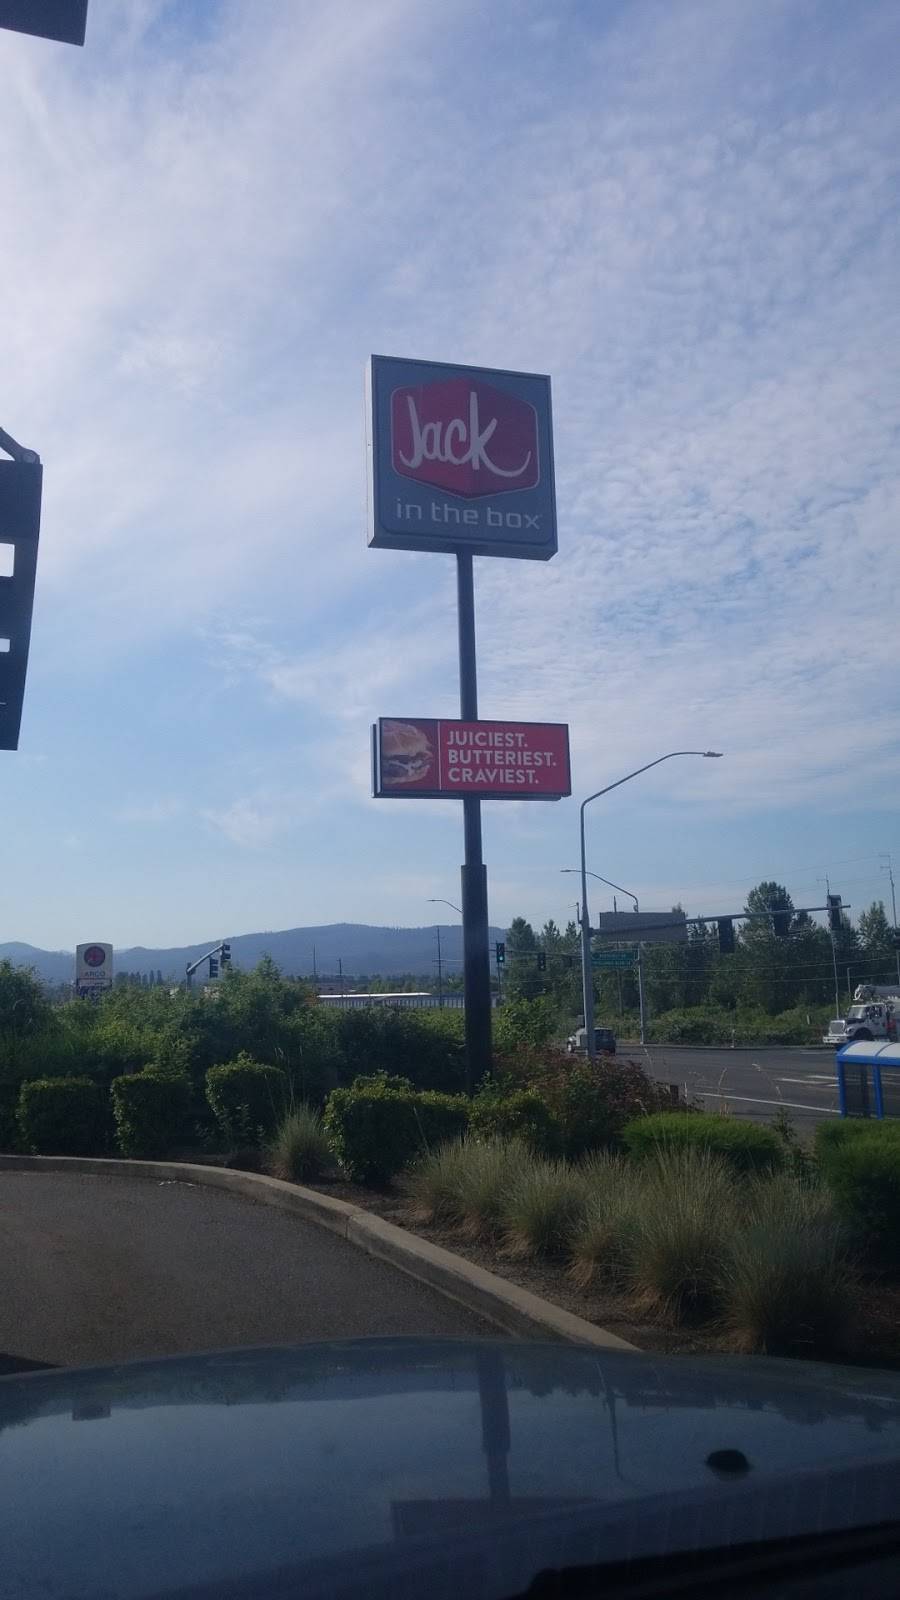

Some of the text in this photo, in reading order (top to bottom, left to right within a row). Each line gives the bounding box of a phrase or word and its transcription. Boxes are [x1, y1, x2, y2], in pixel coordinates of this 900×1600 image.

[399, 391, 531, 478] Jack
[396, 498, 541, 530] in the box
[446, 731, 528, 748] JUICIEST.
[448, 749, 557, 767] BUTTERIEST.
[448, 767, 540, 784] CRAVIEST.
